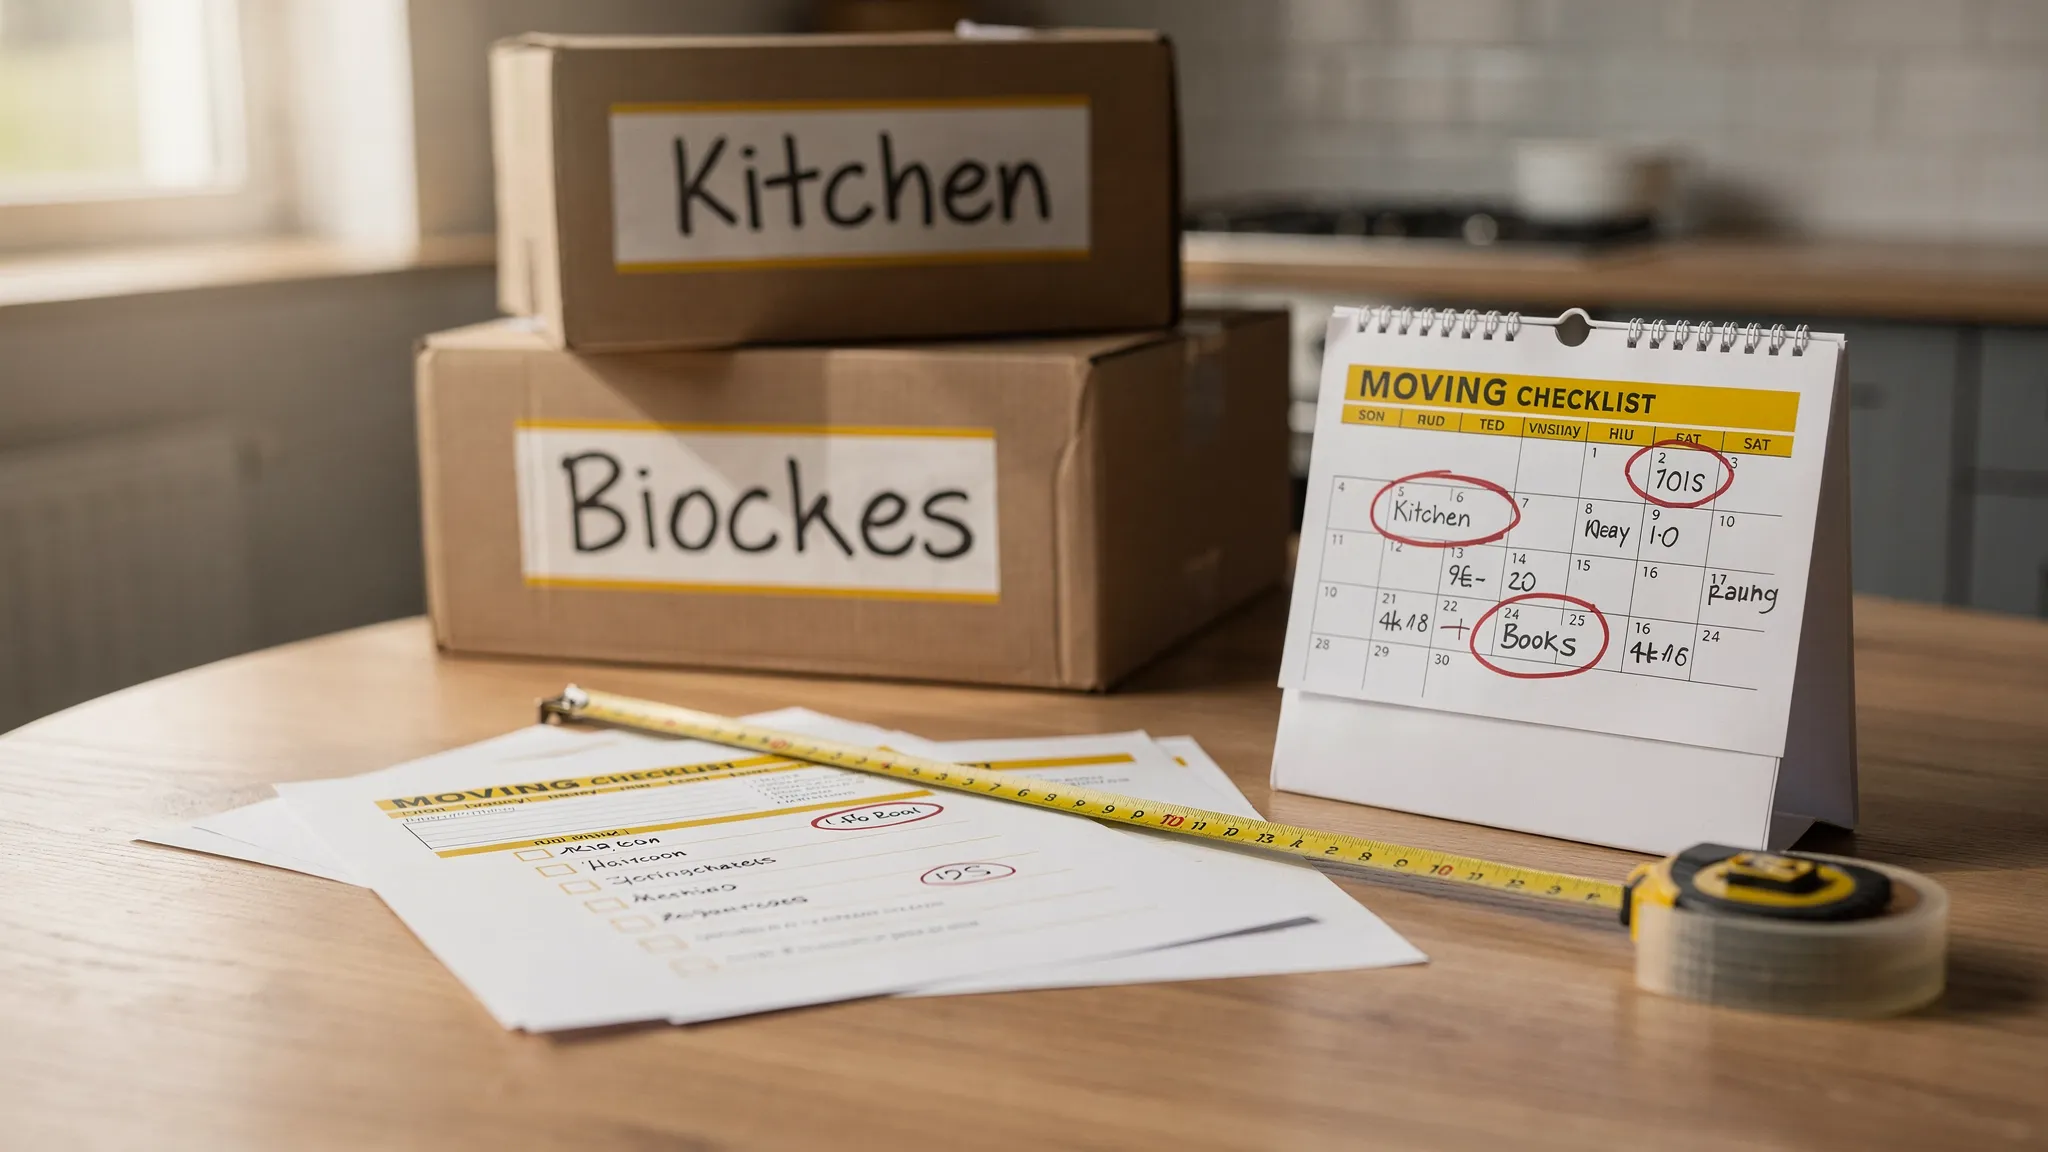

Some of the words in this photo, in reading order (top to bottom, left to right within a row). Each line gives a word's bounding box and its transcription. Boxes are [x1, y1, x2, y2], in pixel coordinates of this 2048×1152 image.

[672, 129, 1052, 238] Kitchen
[1360, 370, 1507, 406] MOVING
[1516, 385, 1656, 414] CHECKLIST
[1358, 409, 1385, 422] SON
[1417, 414, 1445, 427] RUD
[1479, 418, 1505, 431] TED
[1743, 437, 1771, 451] SAT
[1592, 447, 1598, 458] 1
[1657, 452, 1667, 464] 2
[1730, 457, 1739, 469] 3
[562, 449, 975, 560] Biockes
[1337, 482, 1345, 492] 4
[1397, 486, 1405, 497] 5
[1456, 492, 1464, 503] 6
[1521, 497, 1530, 509] 7
[1584, 503, 1593, 515] 8
[1652, 510, 1661, 521] 9
[1719, 515, 1735, 528] 10
[1393, 499, 1471, 527] Kitchen
[1331, 534, 1344, 545] 11
[1390, 541, 1403, 553] 12
[1450, 547, 1464, 559] 13
[1512, 552, 1527, 565] 14
[1576, 560, 1591, 571] 15
[1643, 566, 1658, 579] 16
[1711, 573, 1727, 585] 17
[1507, 571, 1537, 592] 20
[1324, 586, 1338, 598] 10
[1381, 593, 1397, 604] 21
[1442, 600, 1458, 612] 22
[1504, 607, 1520, 620] 24
[1569, 613, 1585, 626] 25
[1635, 622, 1651, 635] 16
[1702, 629, 1720, 643] 24
[1314, 638, 1330, 650] 28
[1374, 645, 1390, 658] 29
[1434, 653, 1450, 666] 30
[1500, 622, 1577, 657] Books
[391, 779, 580, 809] MOVING
[590, 762, 735, 786] CHECKLIST
[1102, 804, 1116, 814] 9
[1255, 833, 1275, 844] 13
[1325, 845, 1339, 855] 2
